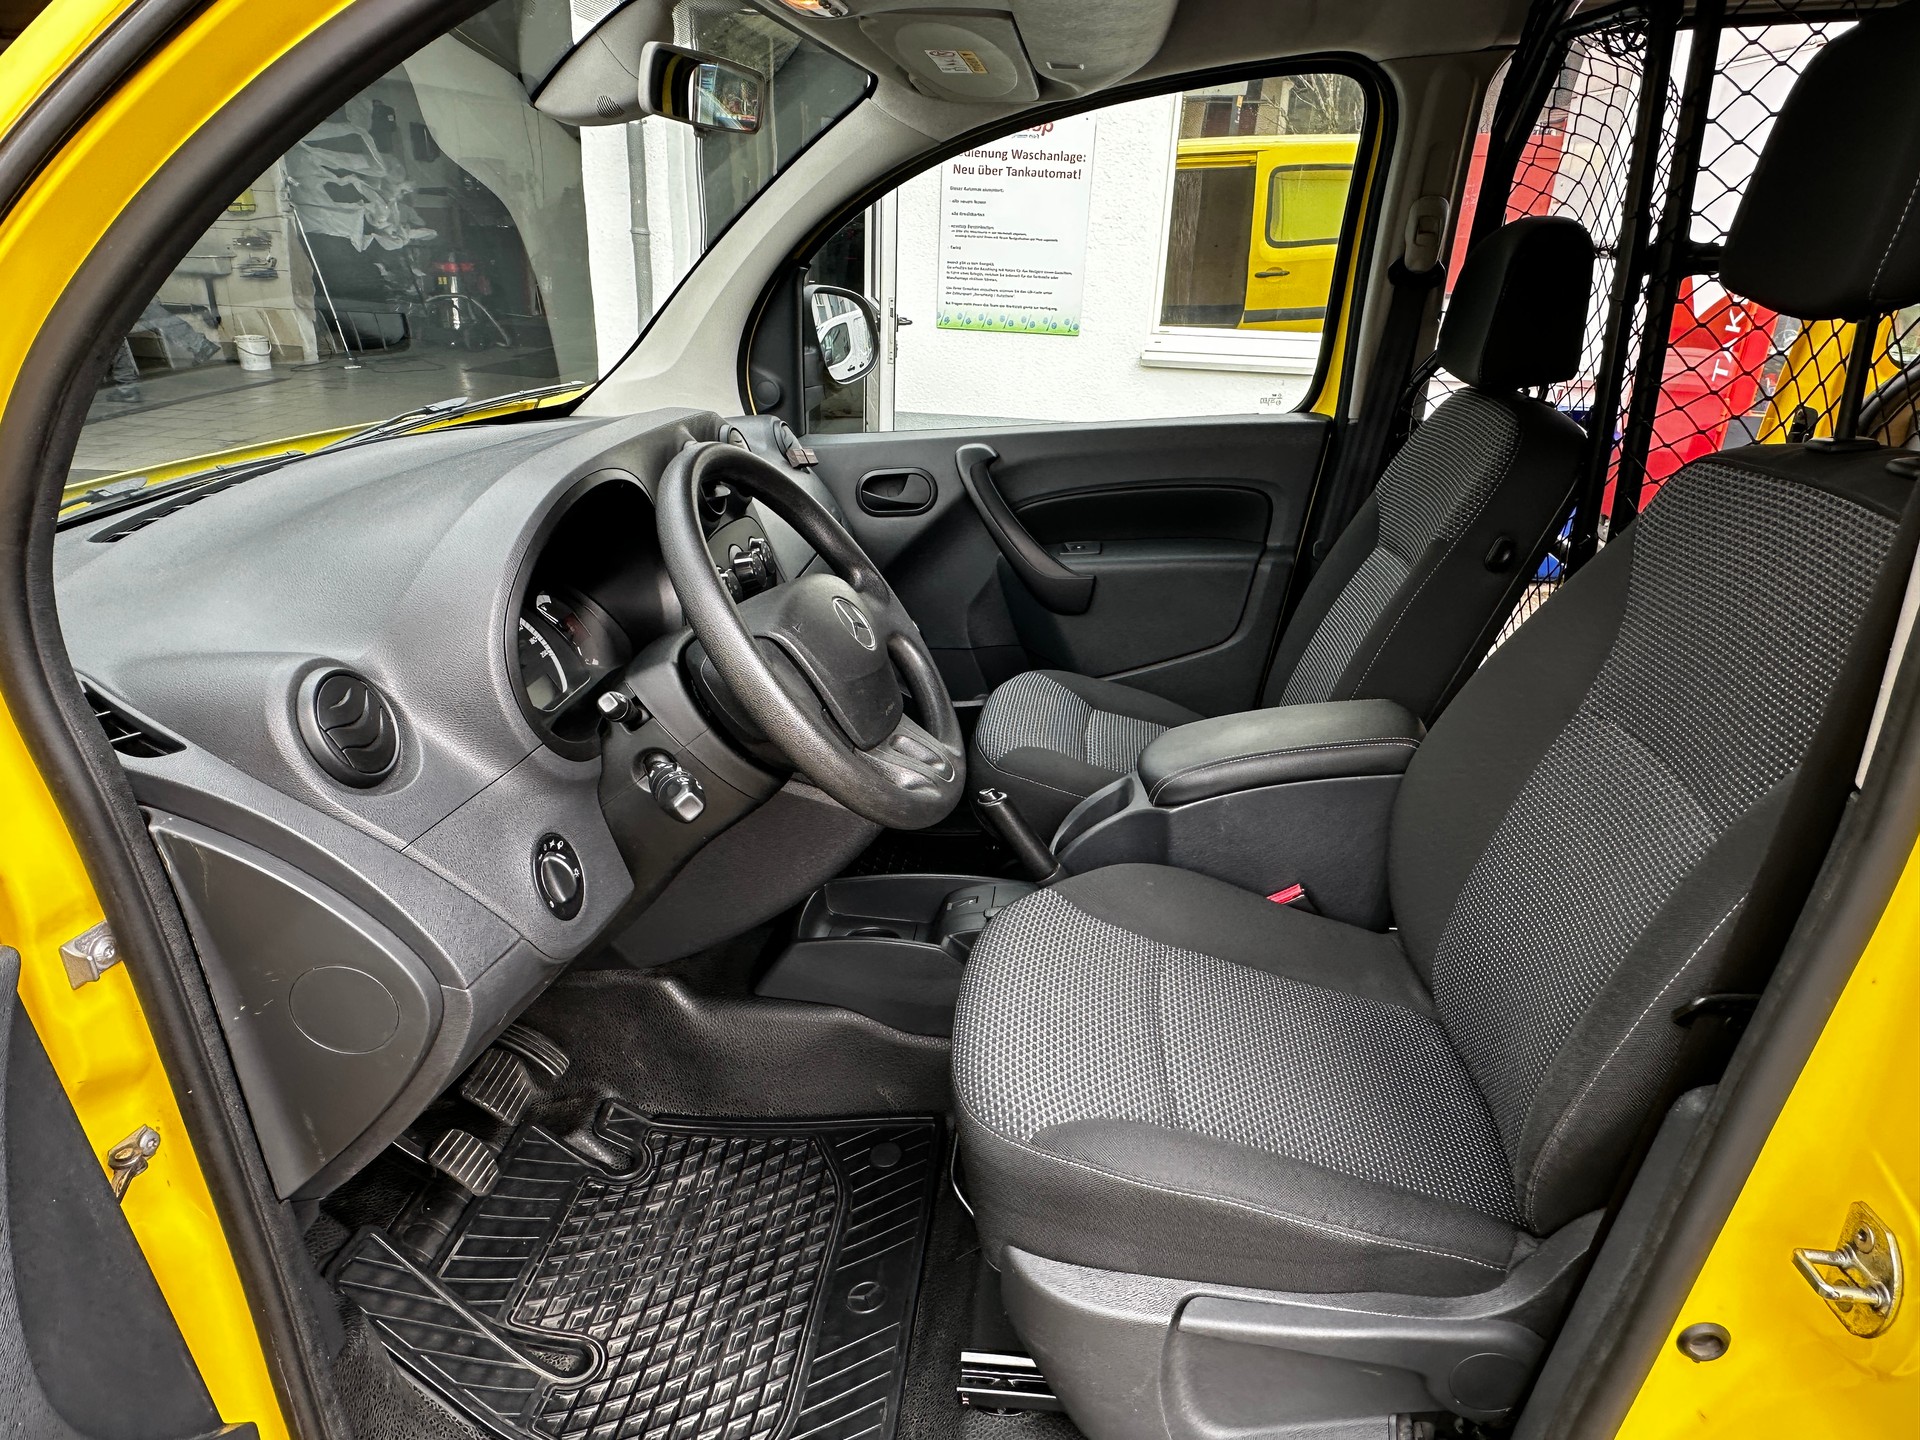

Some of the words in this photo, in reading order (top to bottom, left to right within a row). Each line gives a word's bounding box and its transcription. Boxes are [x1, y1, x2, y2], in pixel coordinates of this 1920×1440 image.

[1011, 149, 1087, 164] Waschanlage:
[952, 163, 975, 175] Neu
[977, 165, 1003, 176] über
[1005, 166, 1082, 180] Tankautomat!
